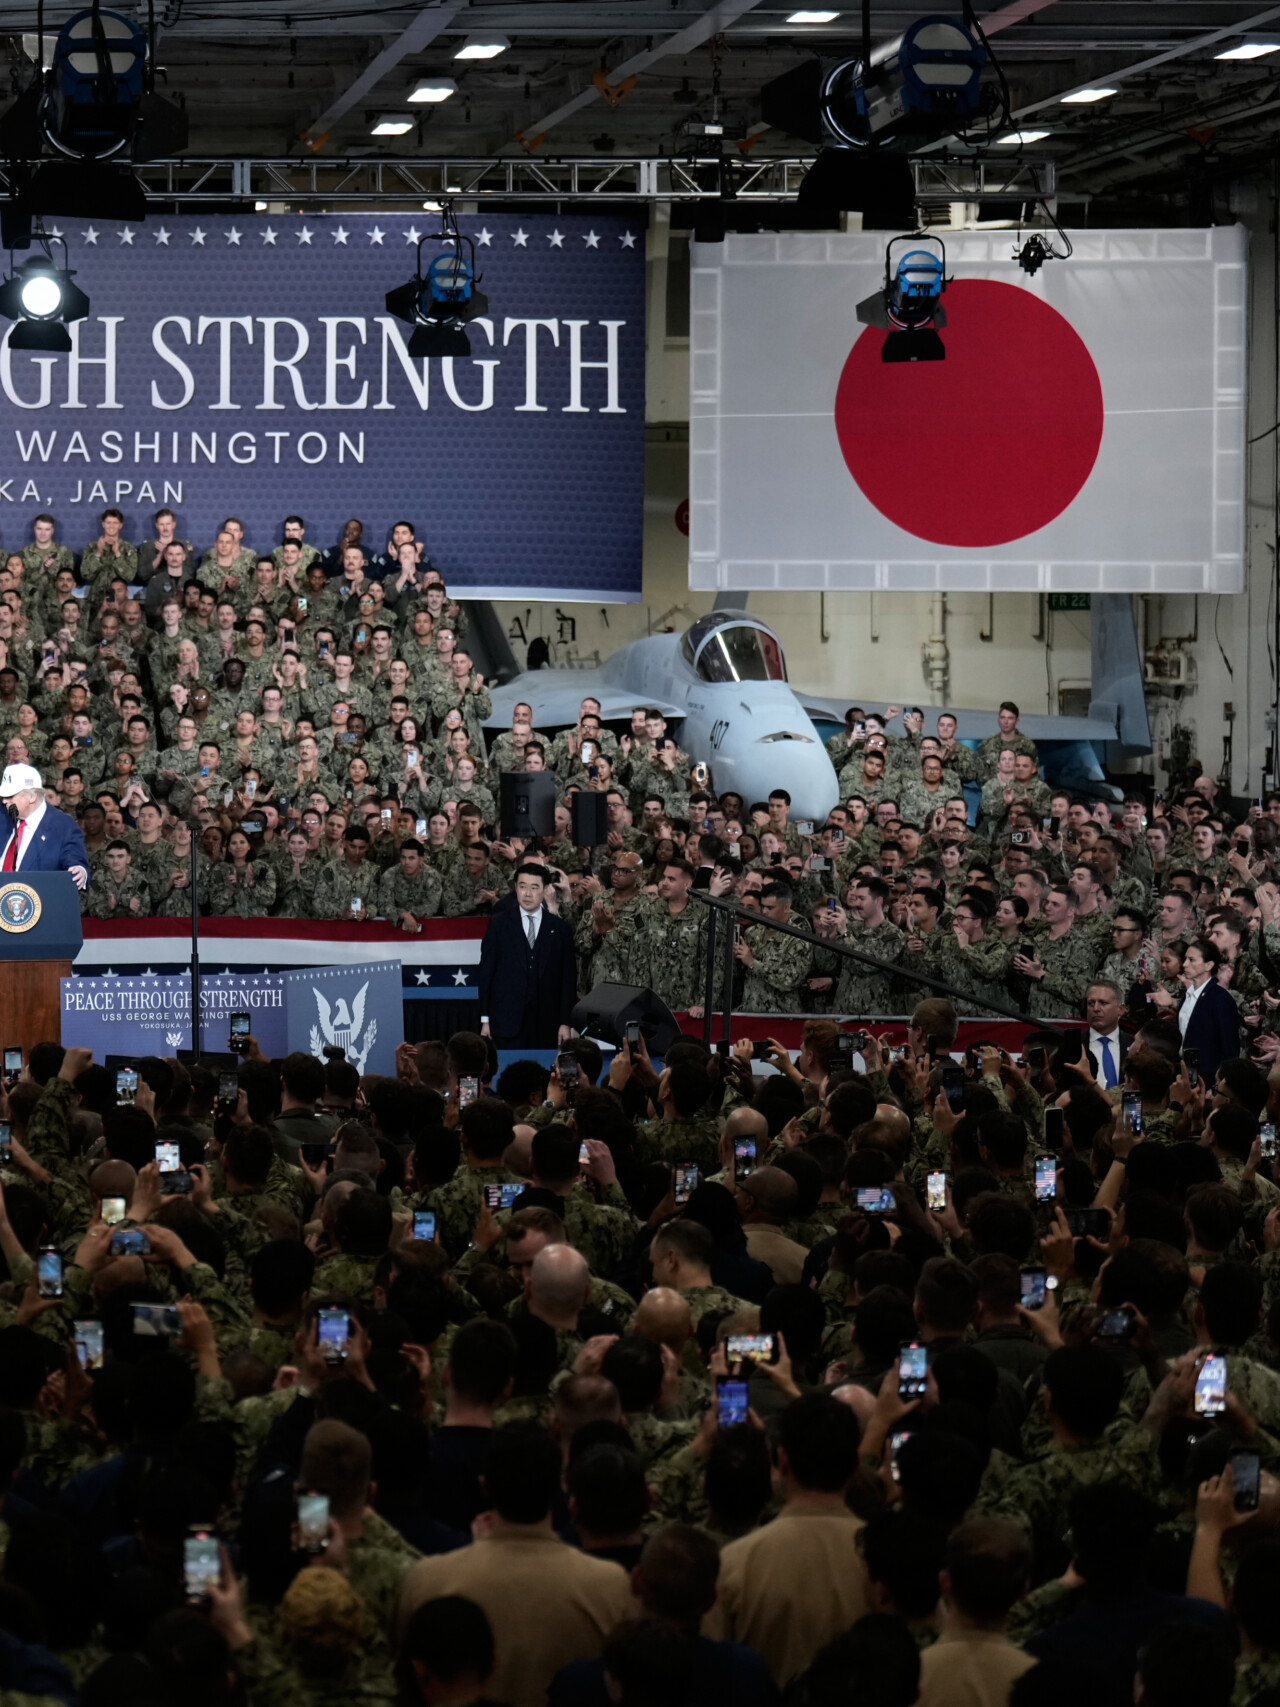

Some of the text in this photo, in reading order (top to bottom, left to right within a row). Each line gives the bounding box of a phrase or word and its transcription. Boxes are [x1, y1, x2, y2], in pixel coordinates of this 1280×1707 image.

[151, 315, 627, 413] STRENGTH
[15, 430, 365, 464] WASHINGTON
[70, 479, 183, 503] JAPAN
[710, 719, 730, 750] 407
[64, 992, 114, 1011] PEACE
[199, 989, 283, 1008] STRENGTH
[101, 1013, 122, 1022] USS
[126, 1012, 170, 1021] GEORGE
